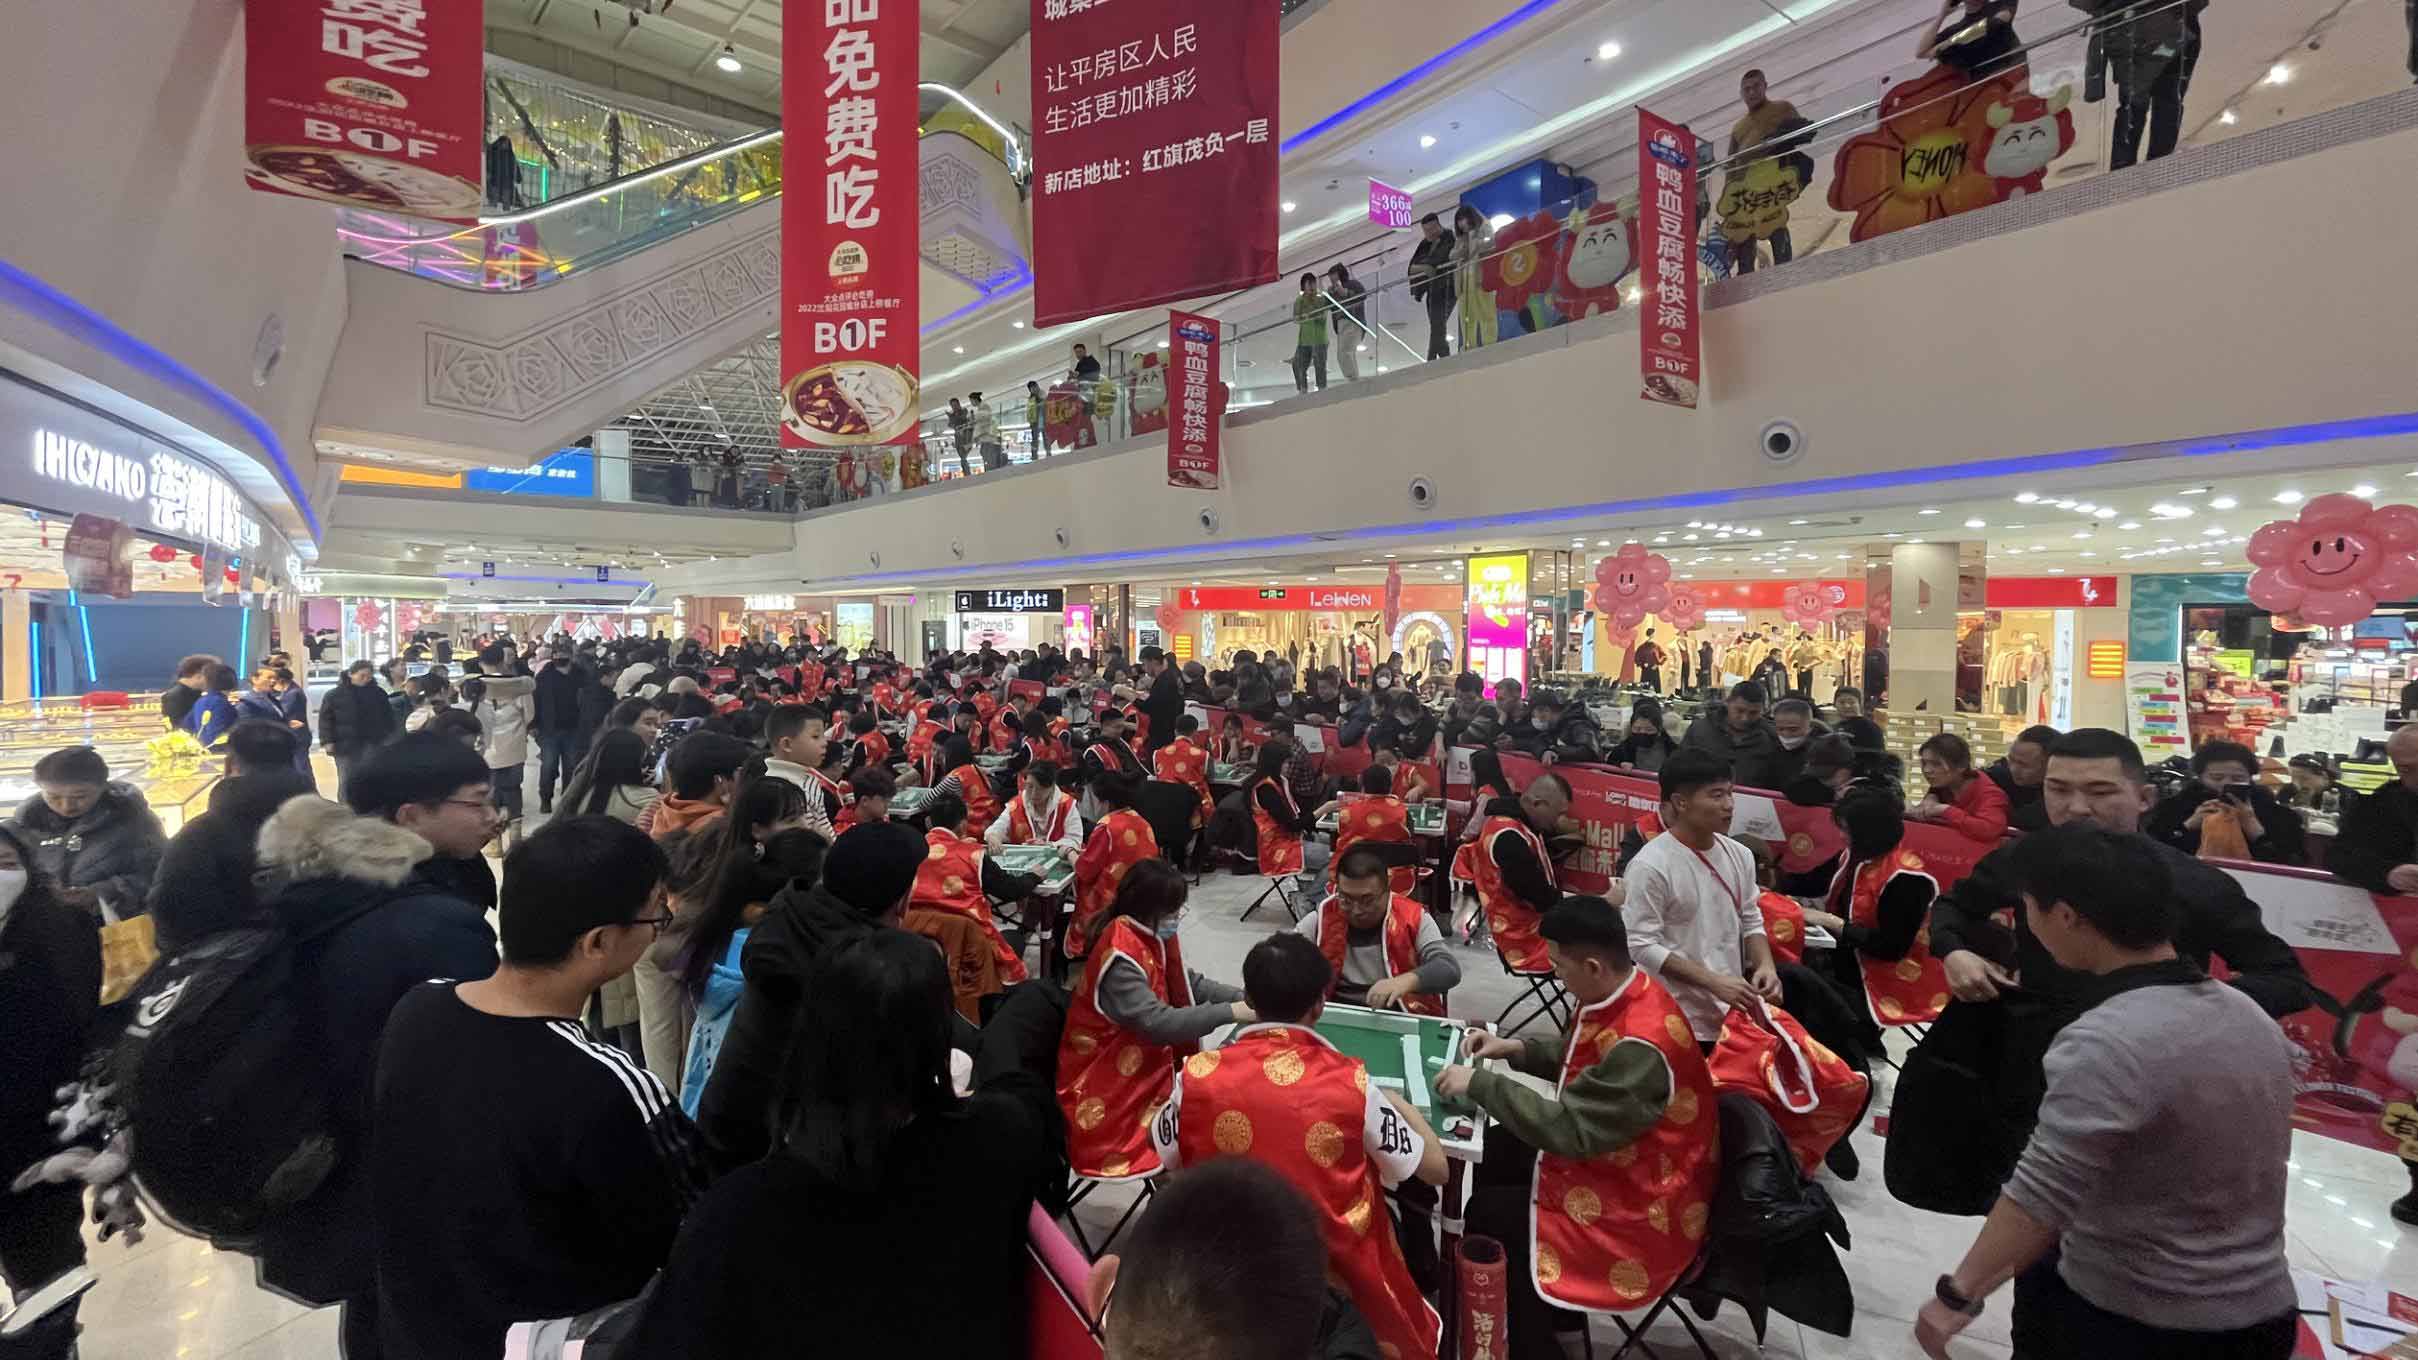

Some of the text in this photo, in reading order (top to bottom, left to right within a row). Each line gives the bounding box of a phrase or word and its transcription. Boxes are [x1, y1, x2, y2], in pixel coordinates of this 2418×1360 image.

[1044, 23, 1198, 94] 让平房区人民
[1044, 67, 1198, 135] 生活更加精彩
[1044, 117, 1270, 195] 新店地址：红旗茂负一层
[1389, 210, 1412, 226] 100
[1655, 162, 1687, 330] 鸭血豆腐畅快添
[970, 617, 1015, 632] iPhone 15
